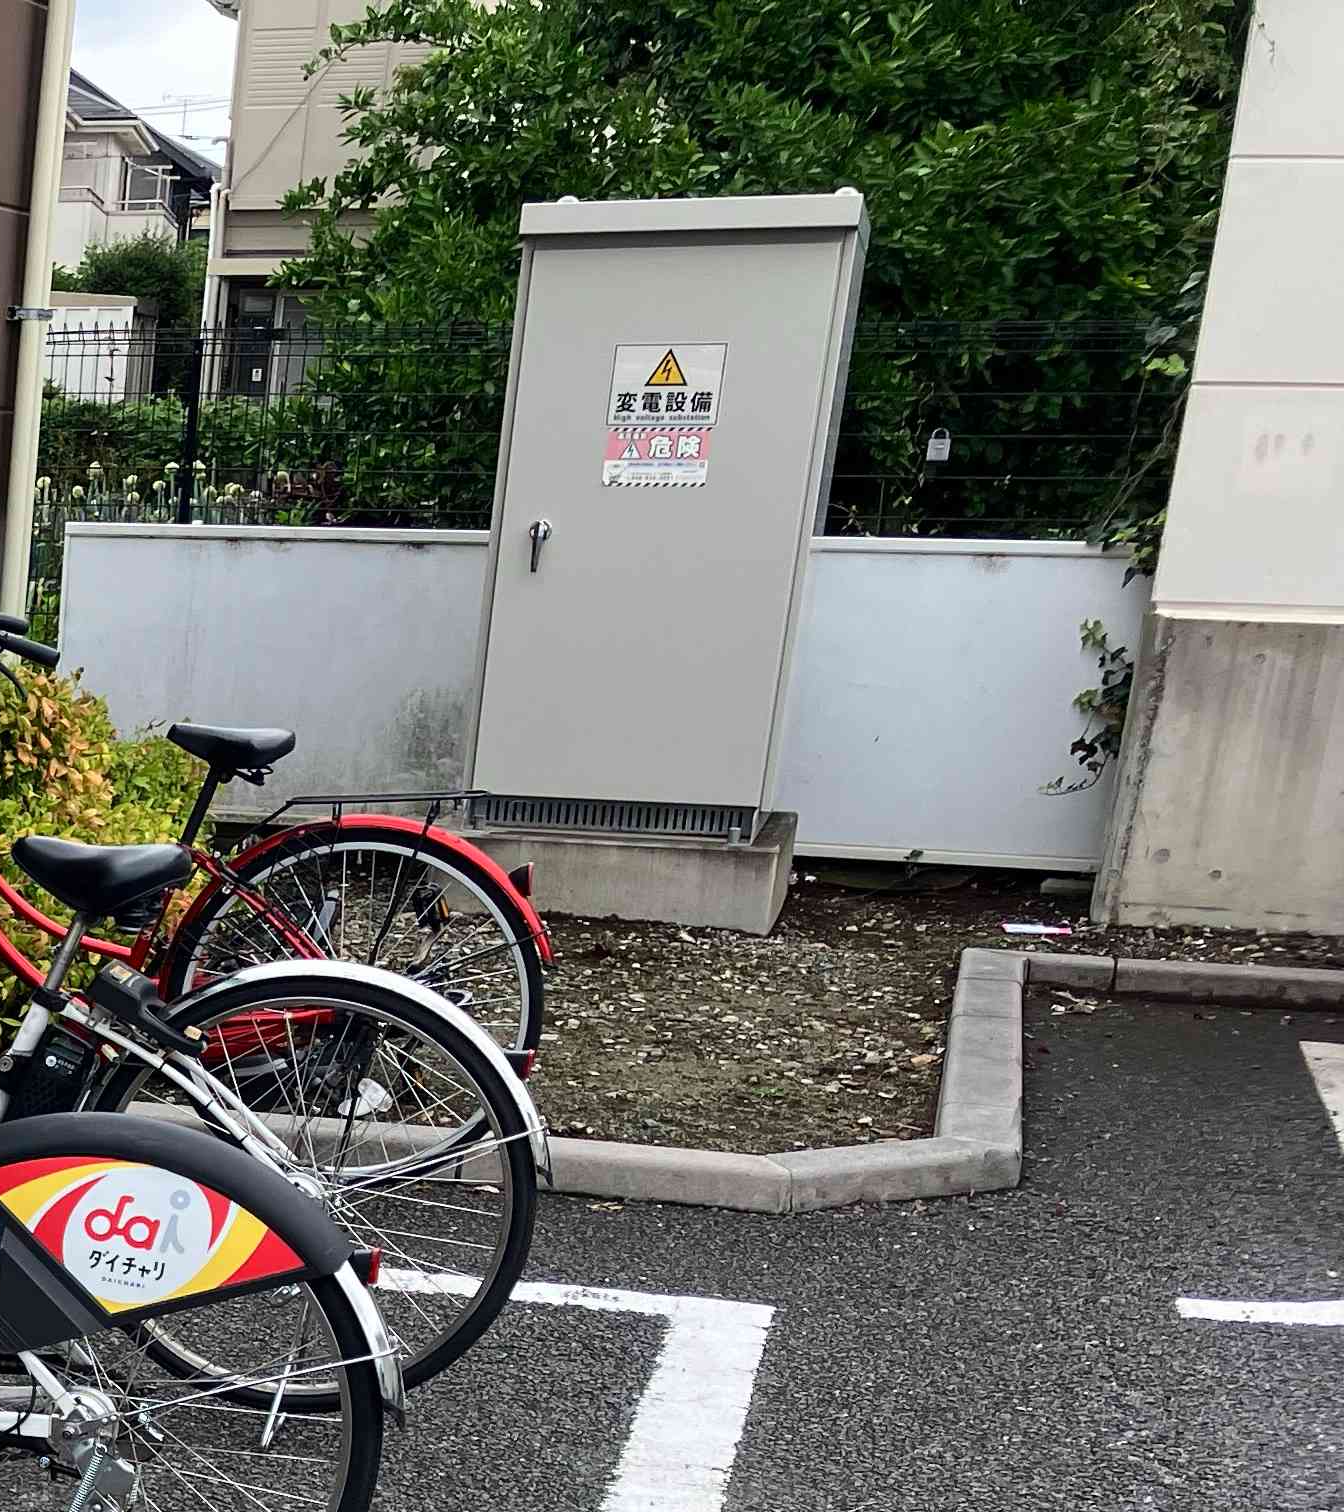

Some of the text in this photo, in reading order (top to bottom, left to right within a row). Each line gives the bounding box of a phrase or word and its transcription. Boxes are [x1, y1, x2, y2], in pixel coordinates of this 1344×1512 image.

[615, 392, 713, 413] 変電設備
[647, 434, 702, 459] 危険
[84, 1189, 191, 1255] dai
[88, 1250, 165, 1281] ダイチャリ
